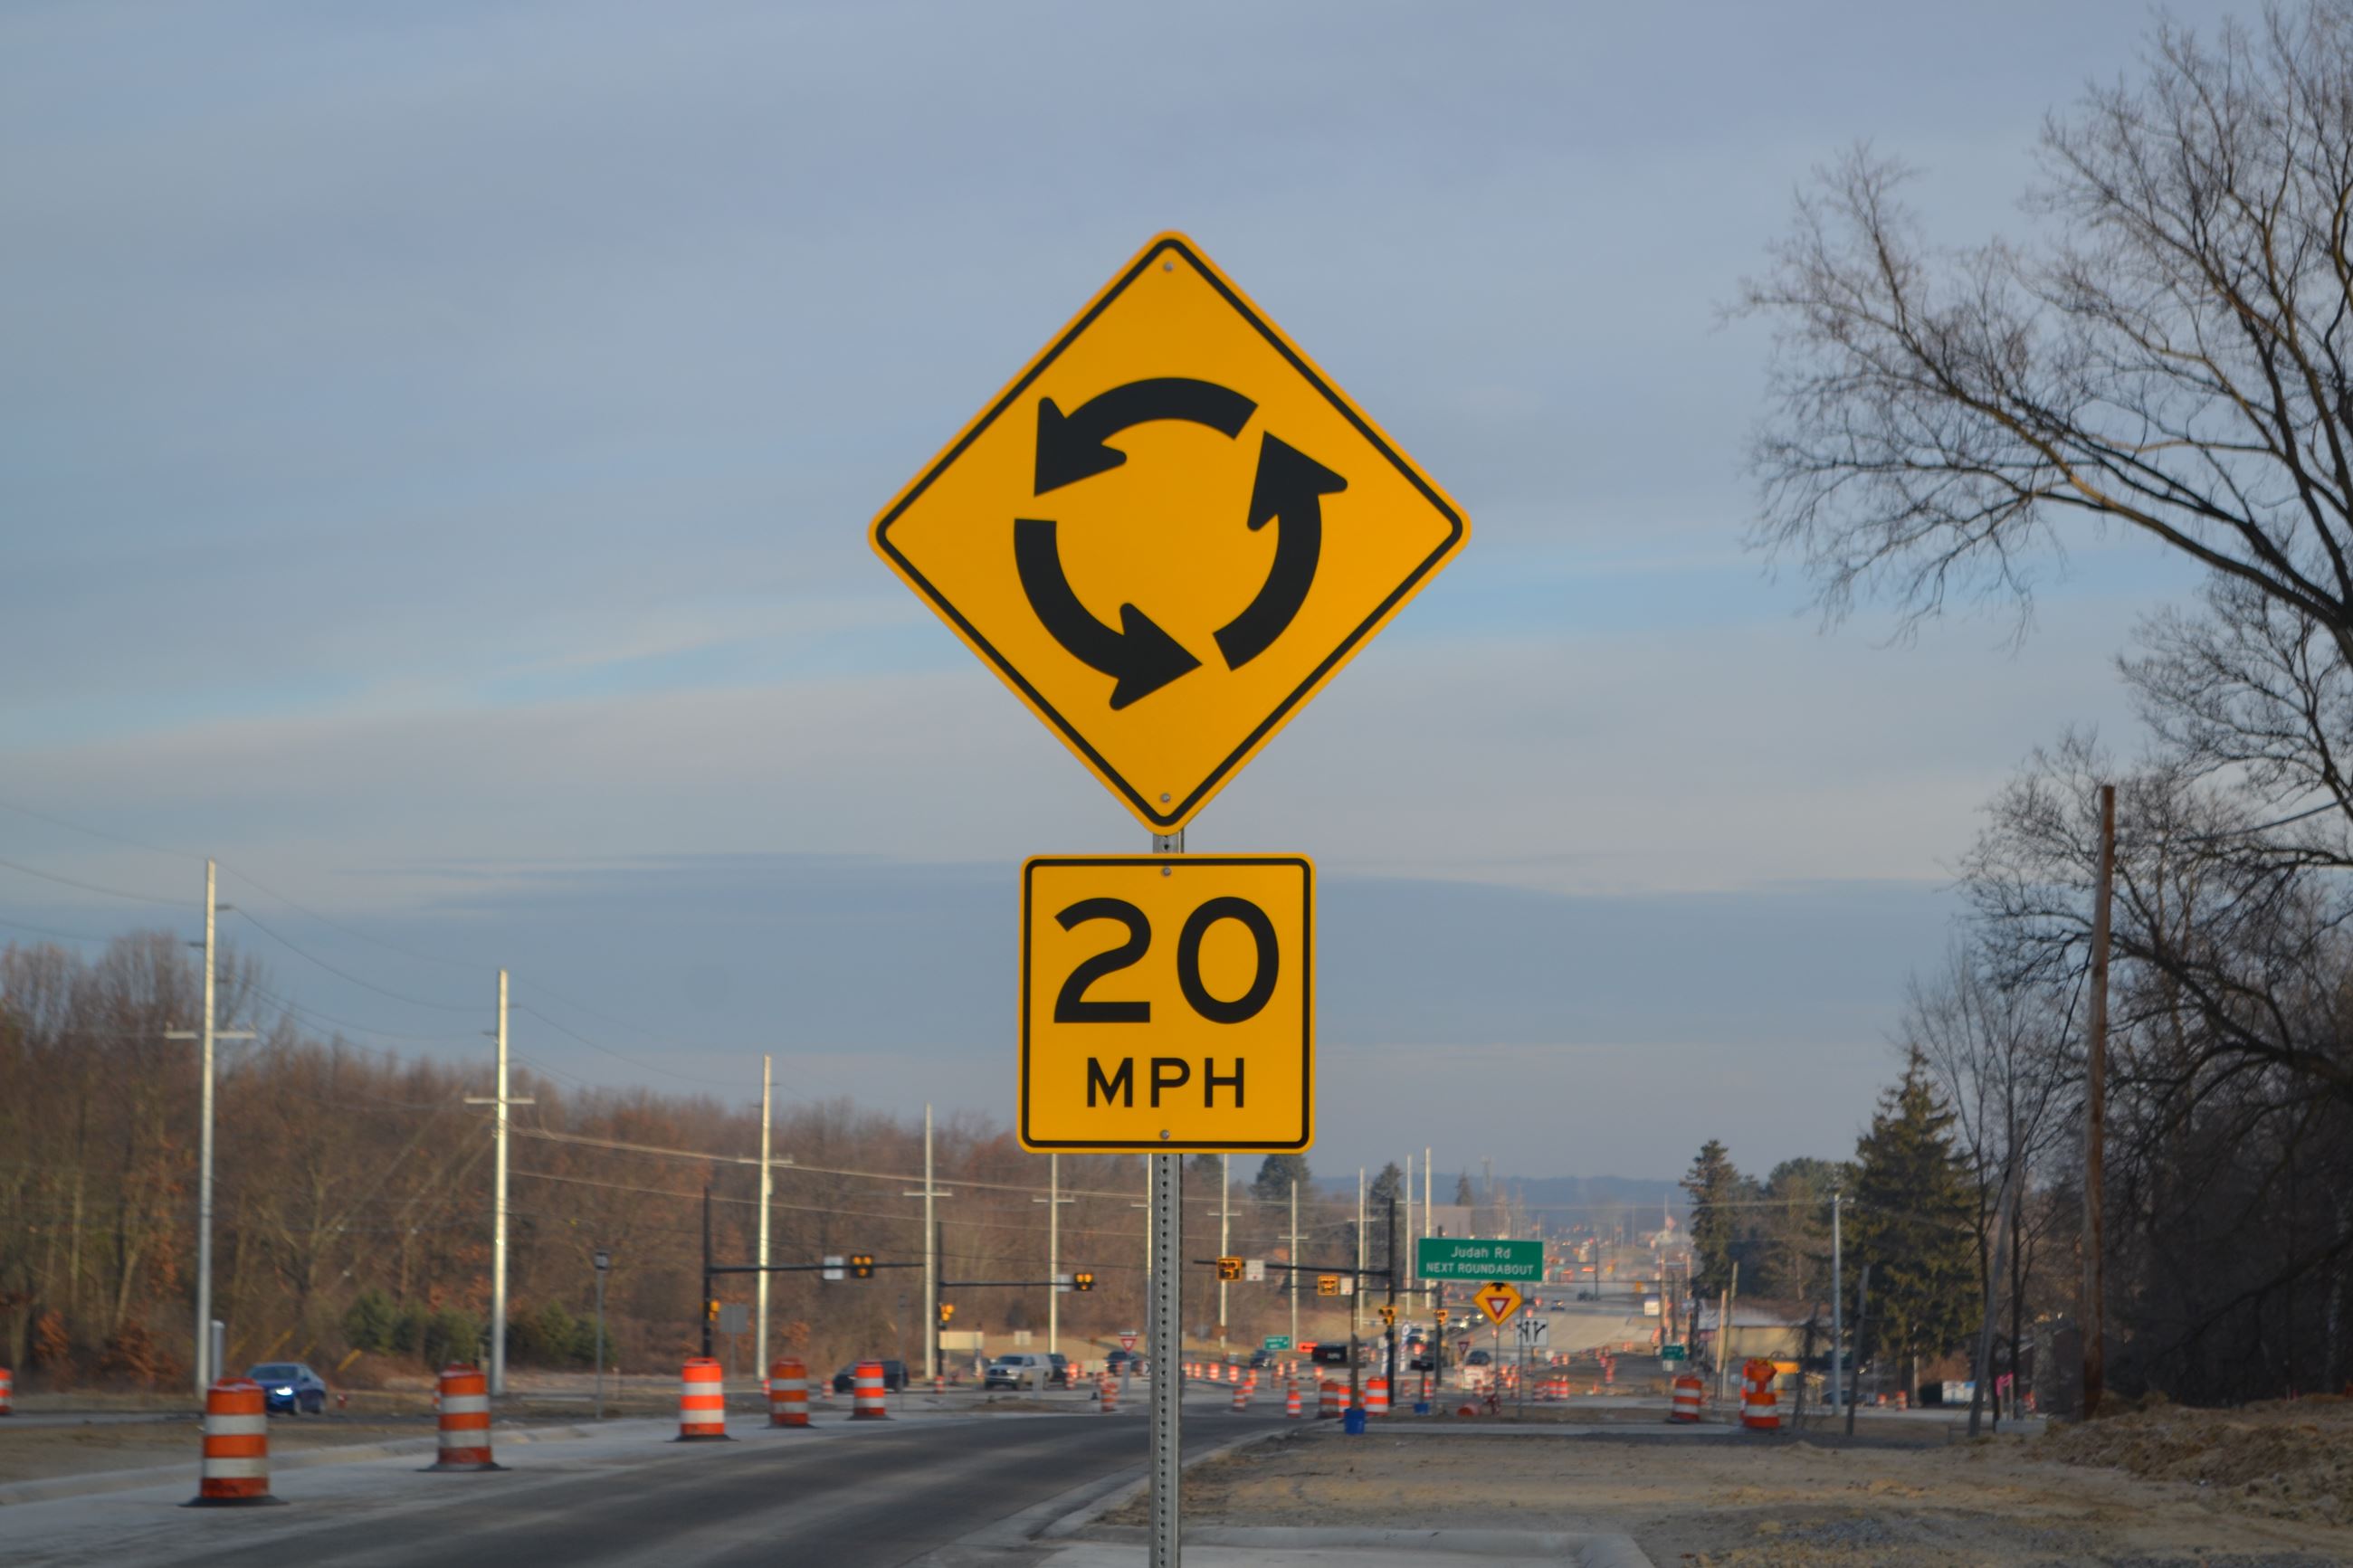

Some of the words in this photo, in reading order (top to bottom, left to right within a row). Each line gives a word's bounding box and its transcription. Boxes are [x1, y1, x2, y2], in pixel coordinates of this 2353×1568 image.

[1053, 896, 1280, 1024] 20
[1087, 1057, 1244, 1108] MPH
[1426, 1262, 1454, 1273] NEXT
[1458, 1263, 1534, 1275] ROUNDABOUT
[1451, 1246, 1489, 1259] Judah
[1494, 1247, 1512, 1259] Rd
